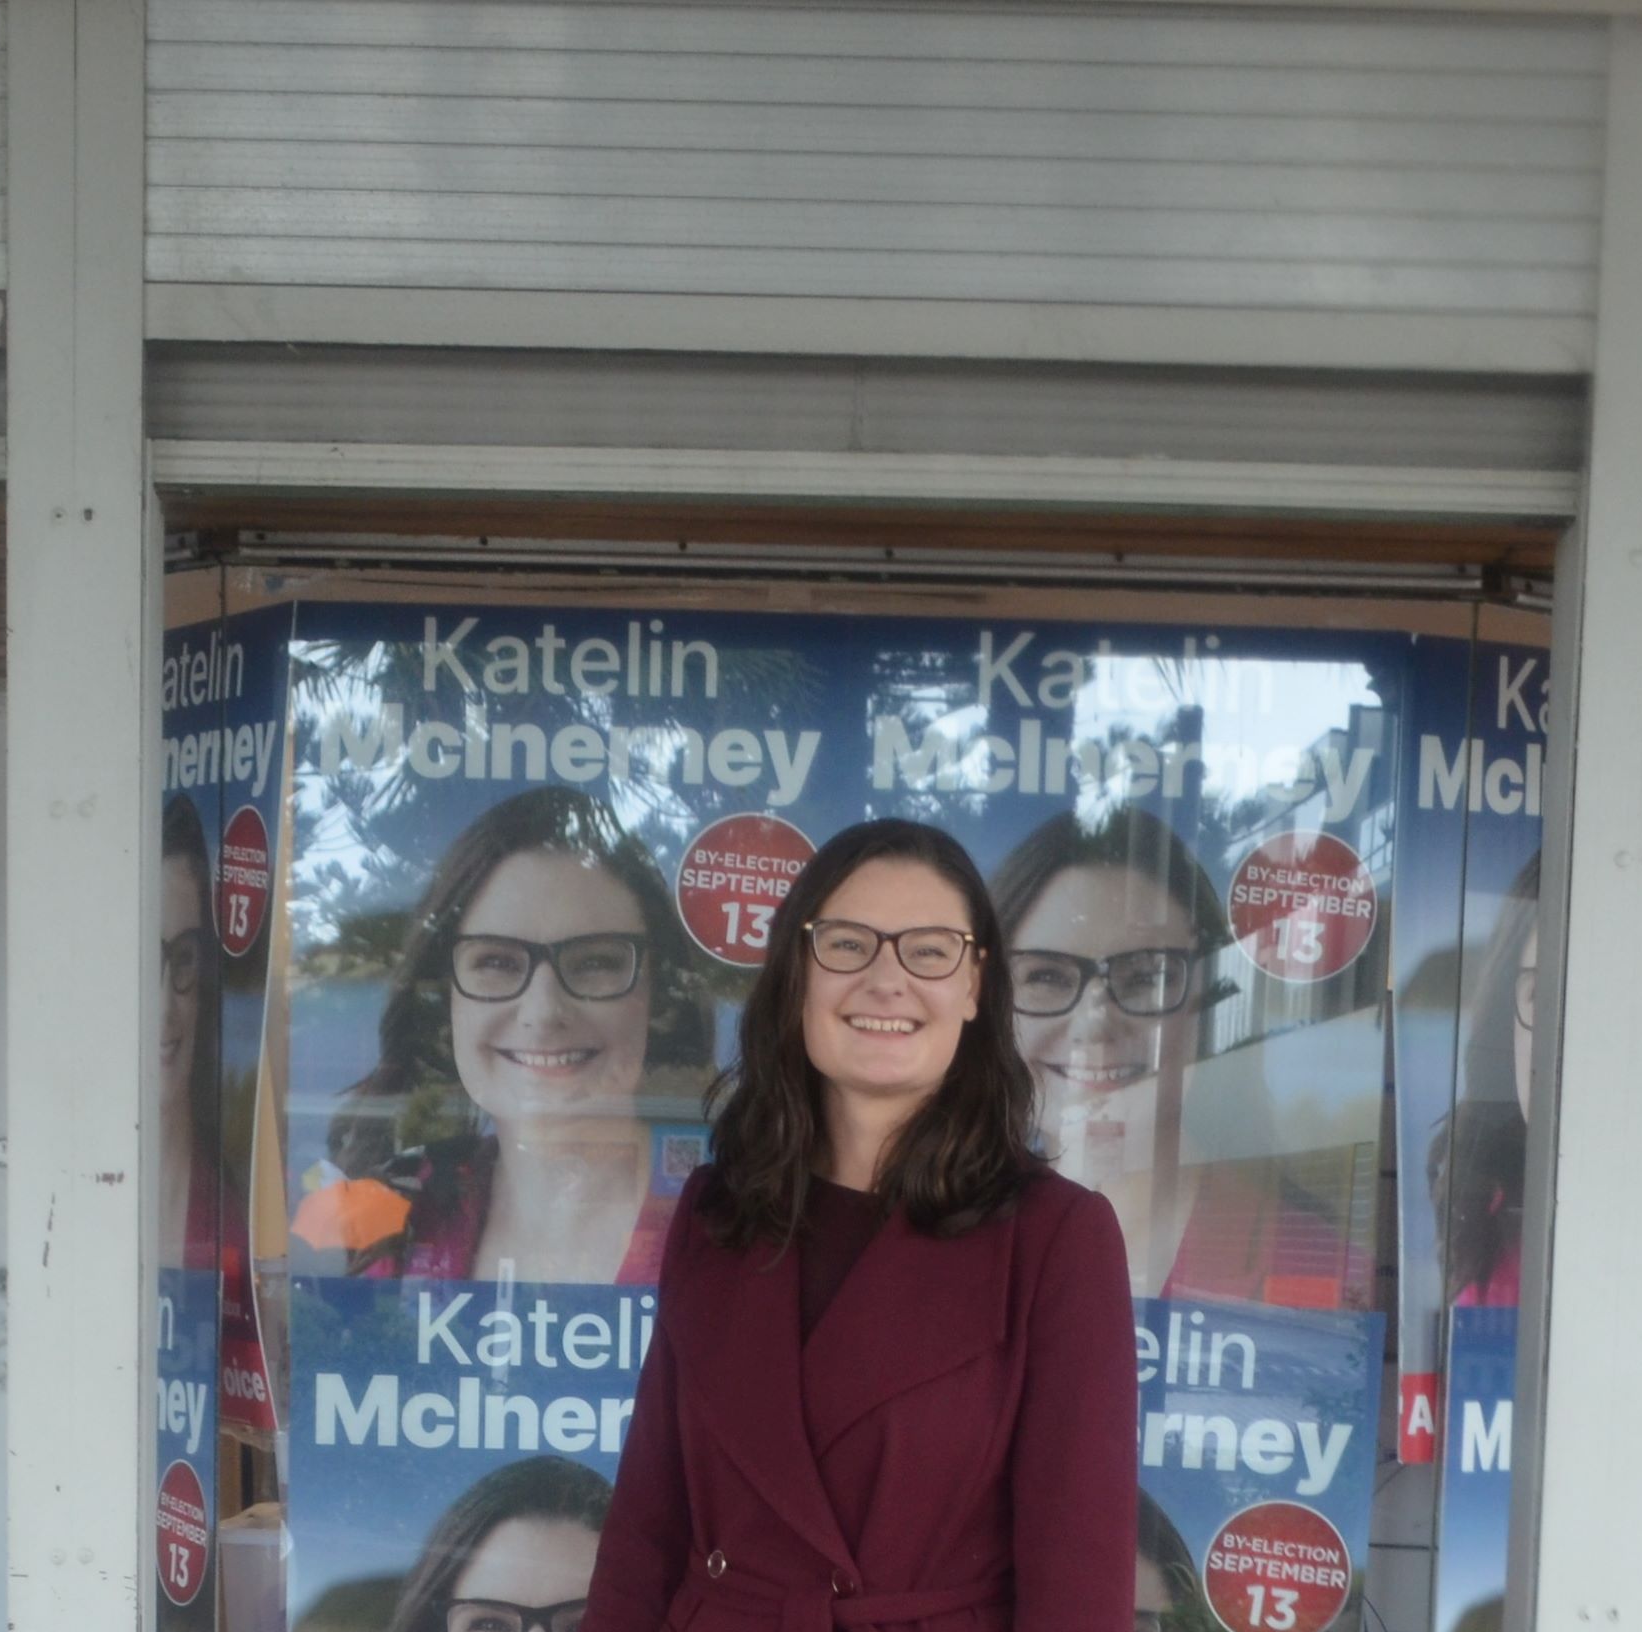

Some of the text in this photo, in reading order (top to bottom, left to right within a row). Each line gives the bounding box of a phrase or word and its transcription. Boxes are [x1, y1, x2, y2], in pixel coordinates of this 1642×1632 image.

[422, 616, 720, 698] Katelin
[979, 630, 1275, 716] Katelin
[319, 703, 822, 806] McInerney
[873, 716, 1375, 823] McInerney
[1246, 864, 1365, 893] BY-ELECTION
[228, 894, 249, 937] 13
[721, 902, 770, 949] 13
[1233, 886, 1372, 919] SEPTEMBER
[1272, 916, 1323, 965] 13
[169, 1542, 189, 1589] 13
[1209, 1552, 1346, 1588] SEPTEMBER
[1223, 1533, 1339, 1565] BY-ELECTION
[1246, 1584, 1299, 1630] 13
